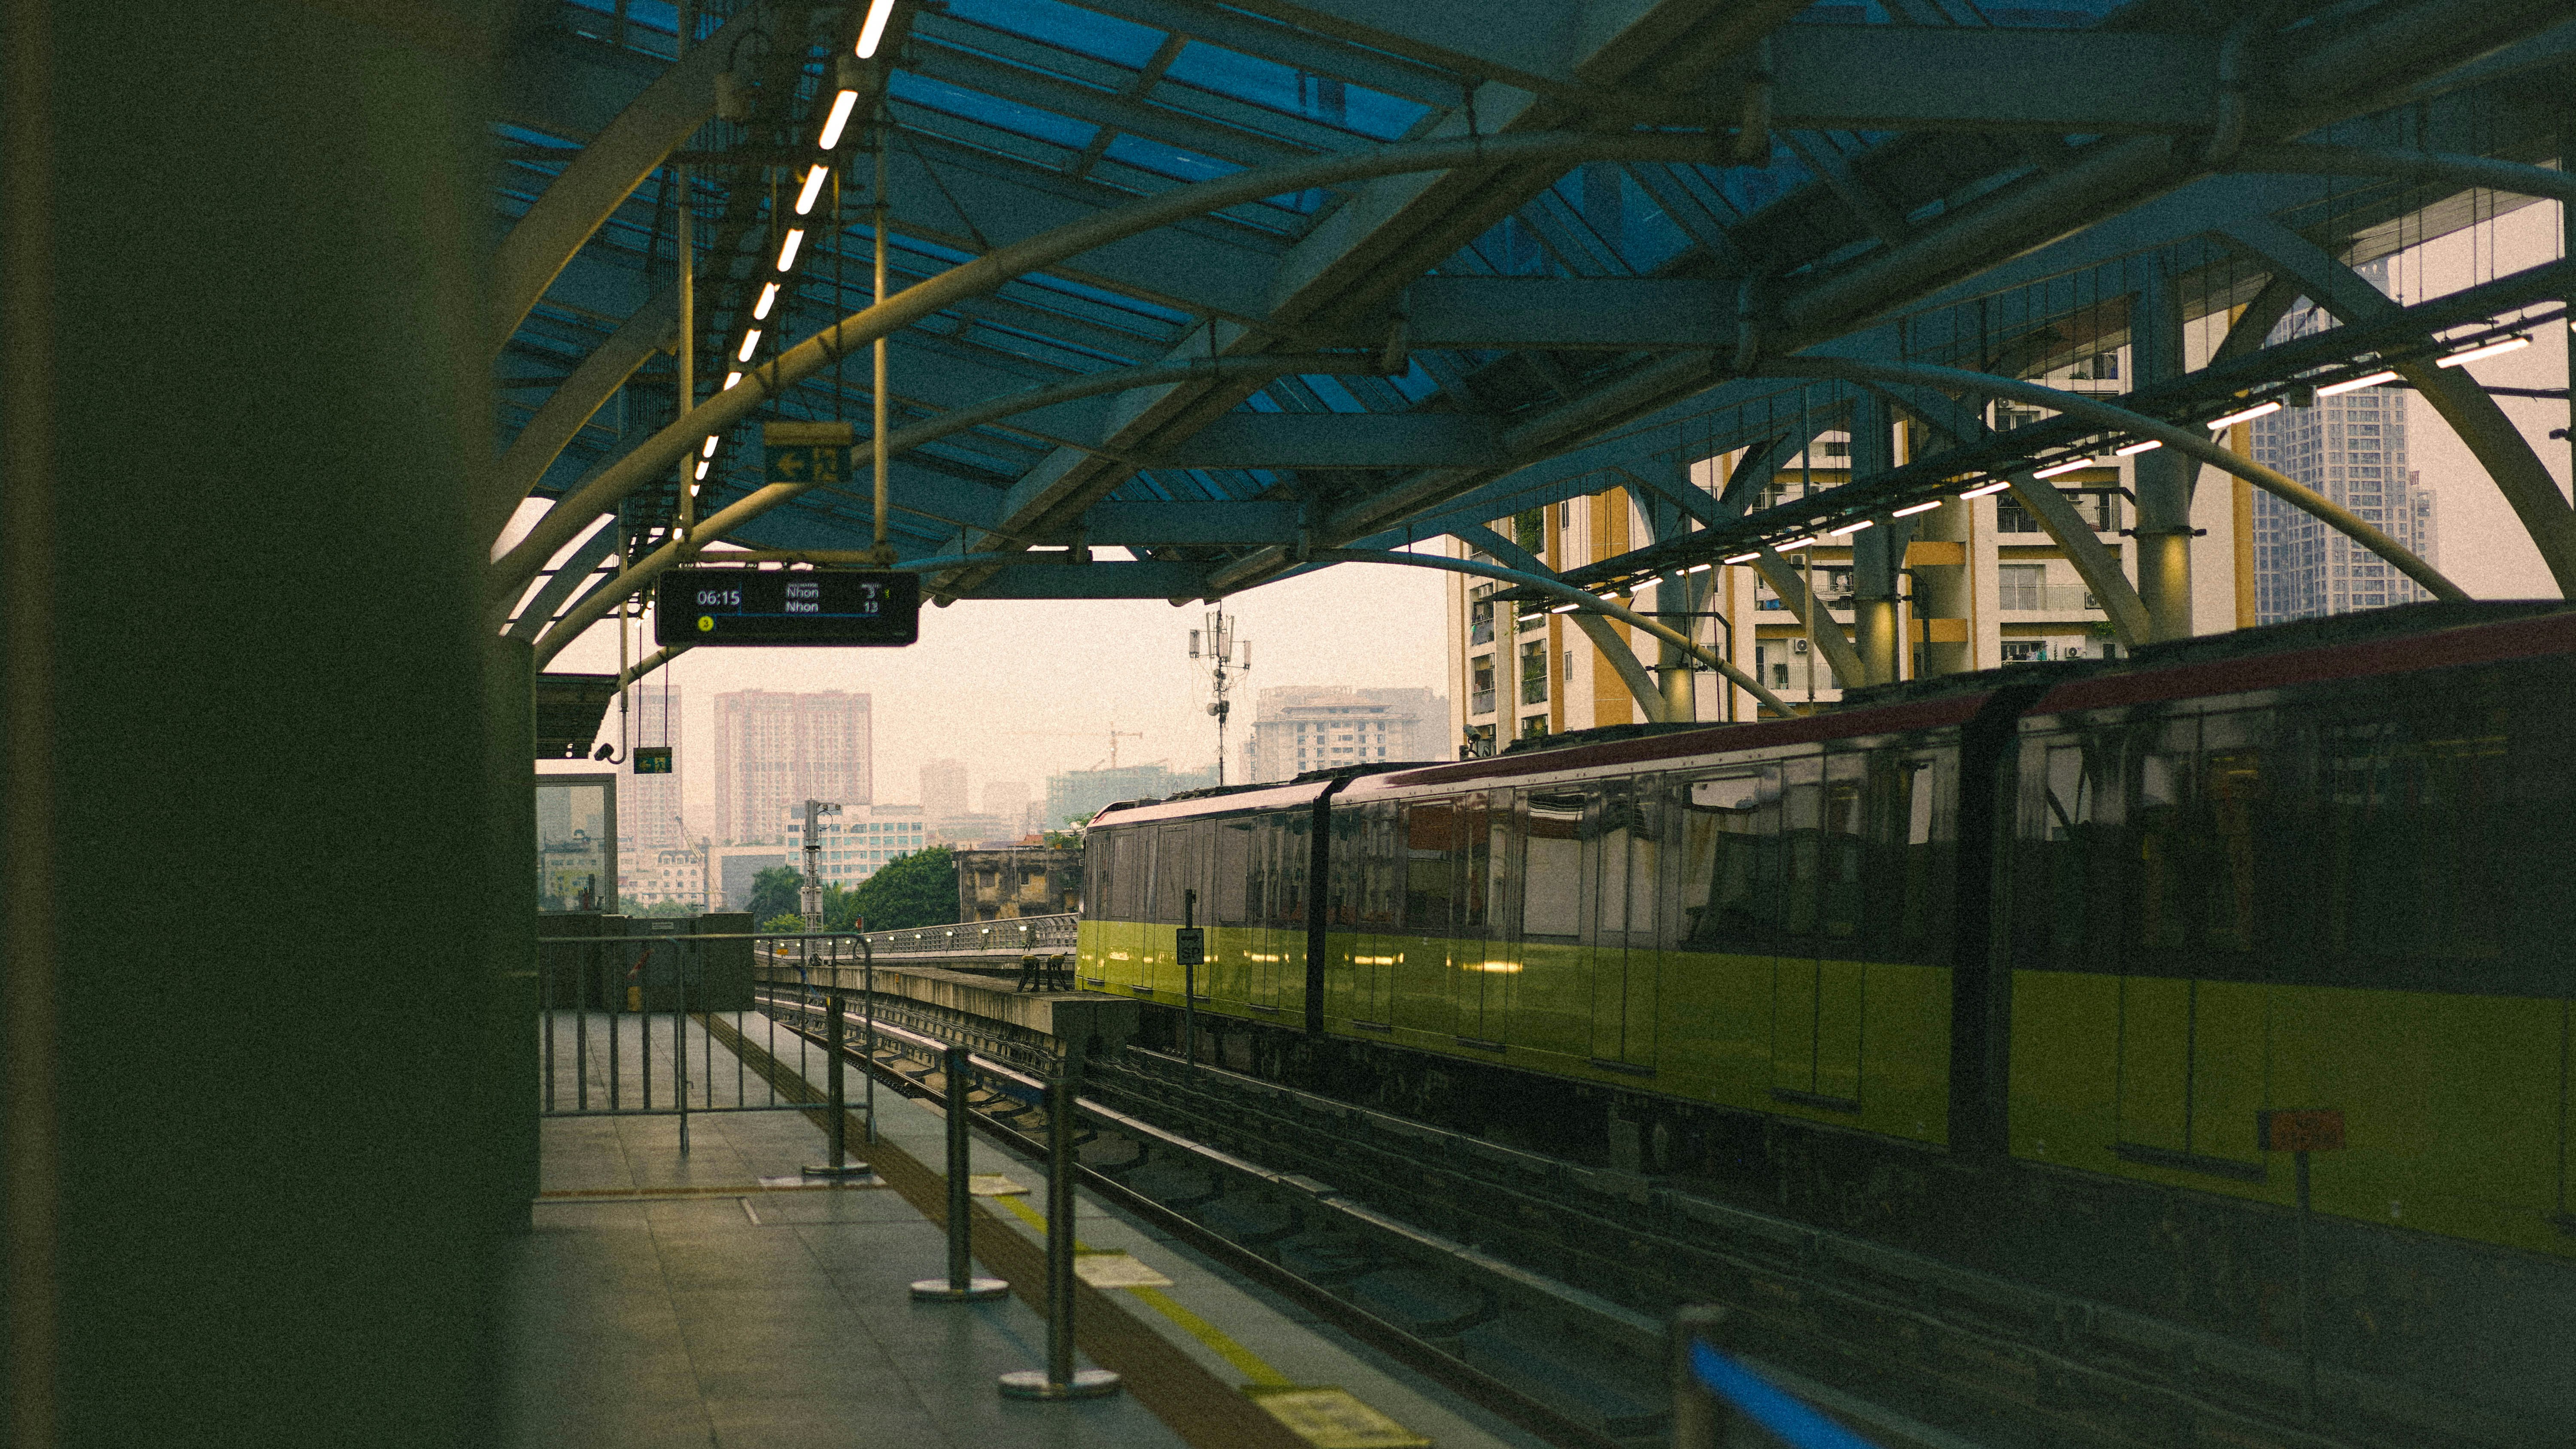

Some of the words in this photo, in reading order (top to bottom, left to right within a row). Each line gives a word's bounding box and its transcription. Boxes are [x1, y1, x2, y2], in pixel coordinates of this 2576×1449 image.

[697, 590, 739, 605] 06:15
[786, 586, 818, 598] Nhon
[867, 587, 875, 598] 3
[786, 601, 818, 612] Nhon
[865, 601, 878, 612] 13
[704, 619, 709, 627] 3
[1181, 947, 1201, 958] SP
